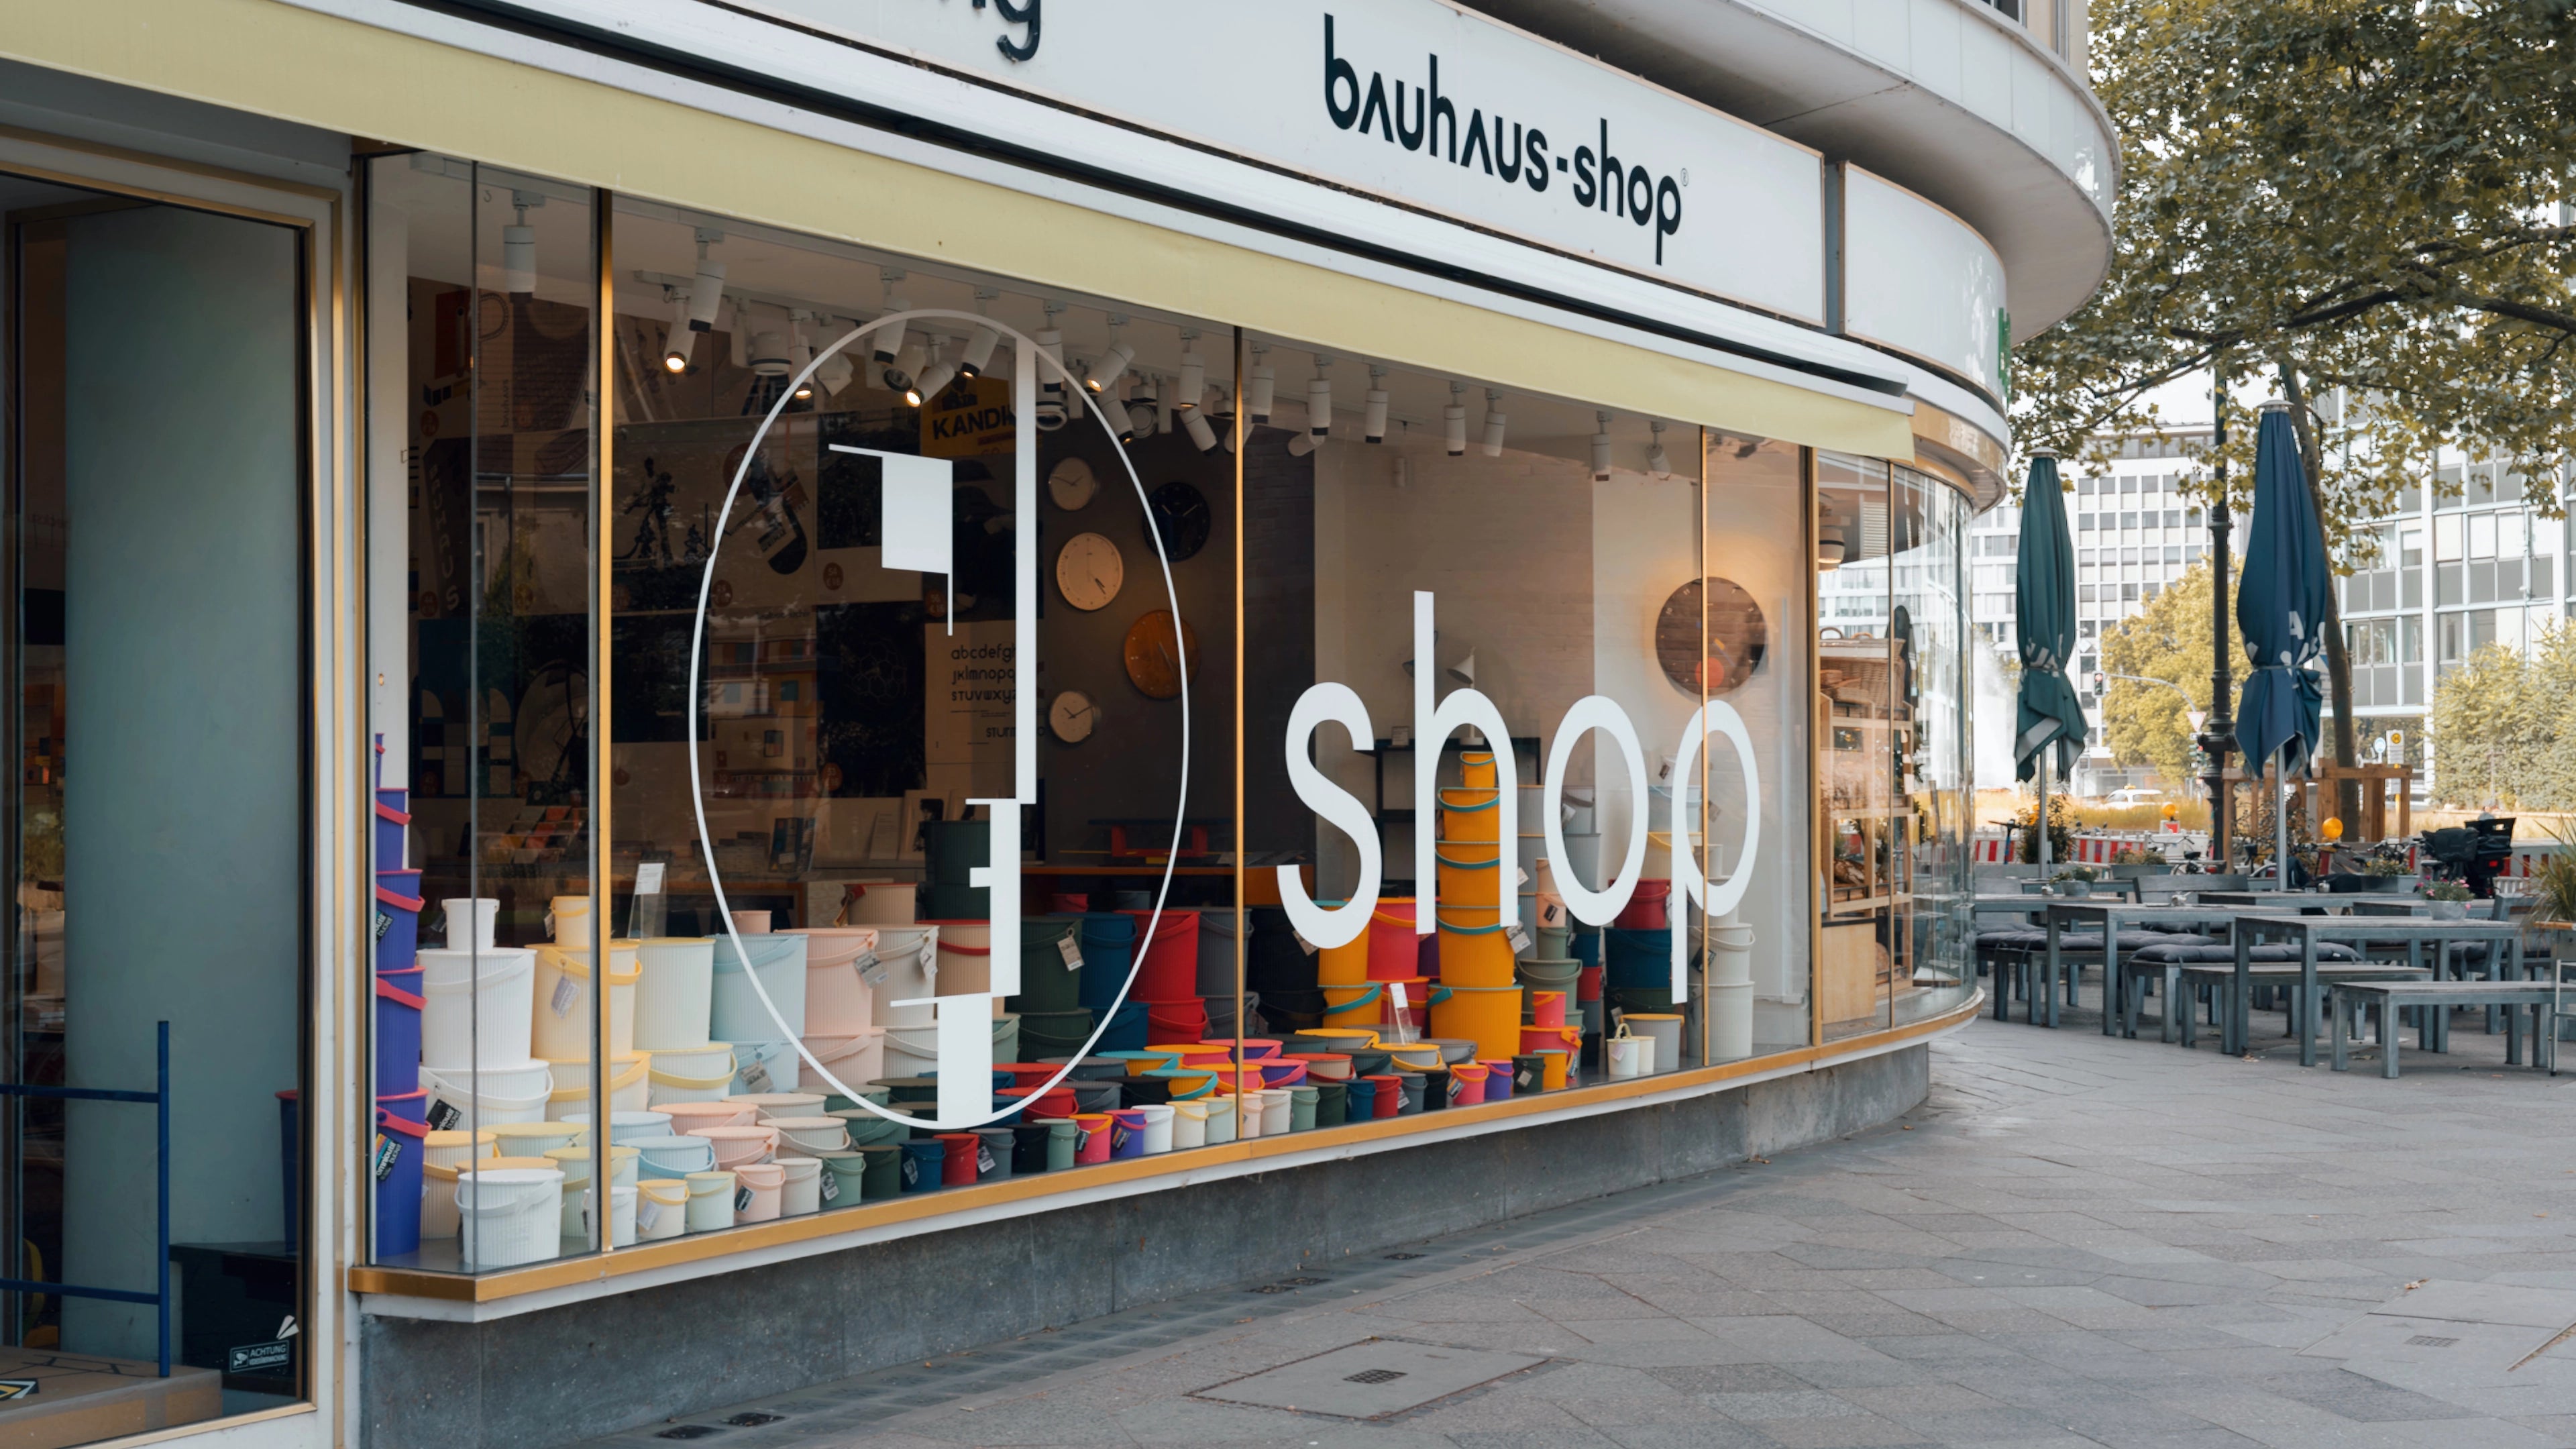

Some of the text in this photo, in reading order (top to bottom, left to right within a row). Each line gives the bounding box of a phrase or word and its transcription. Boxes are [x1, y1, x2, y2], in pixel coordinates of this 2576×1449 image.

[1324, 13, 1682, 265] bauhaus-shop
[932, 405, 1015, 440] KANDI
[1277, 590, 1760, 1004] shop
[250, 1344, 286, 1357] ACHTUNG
